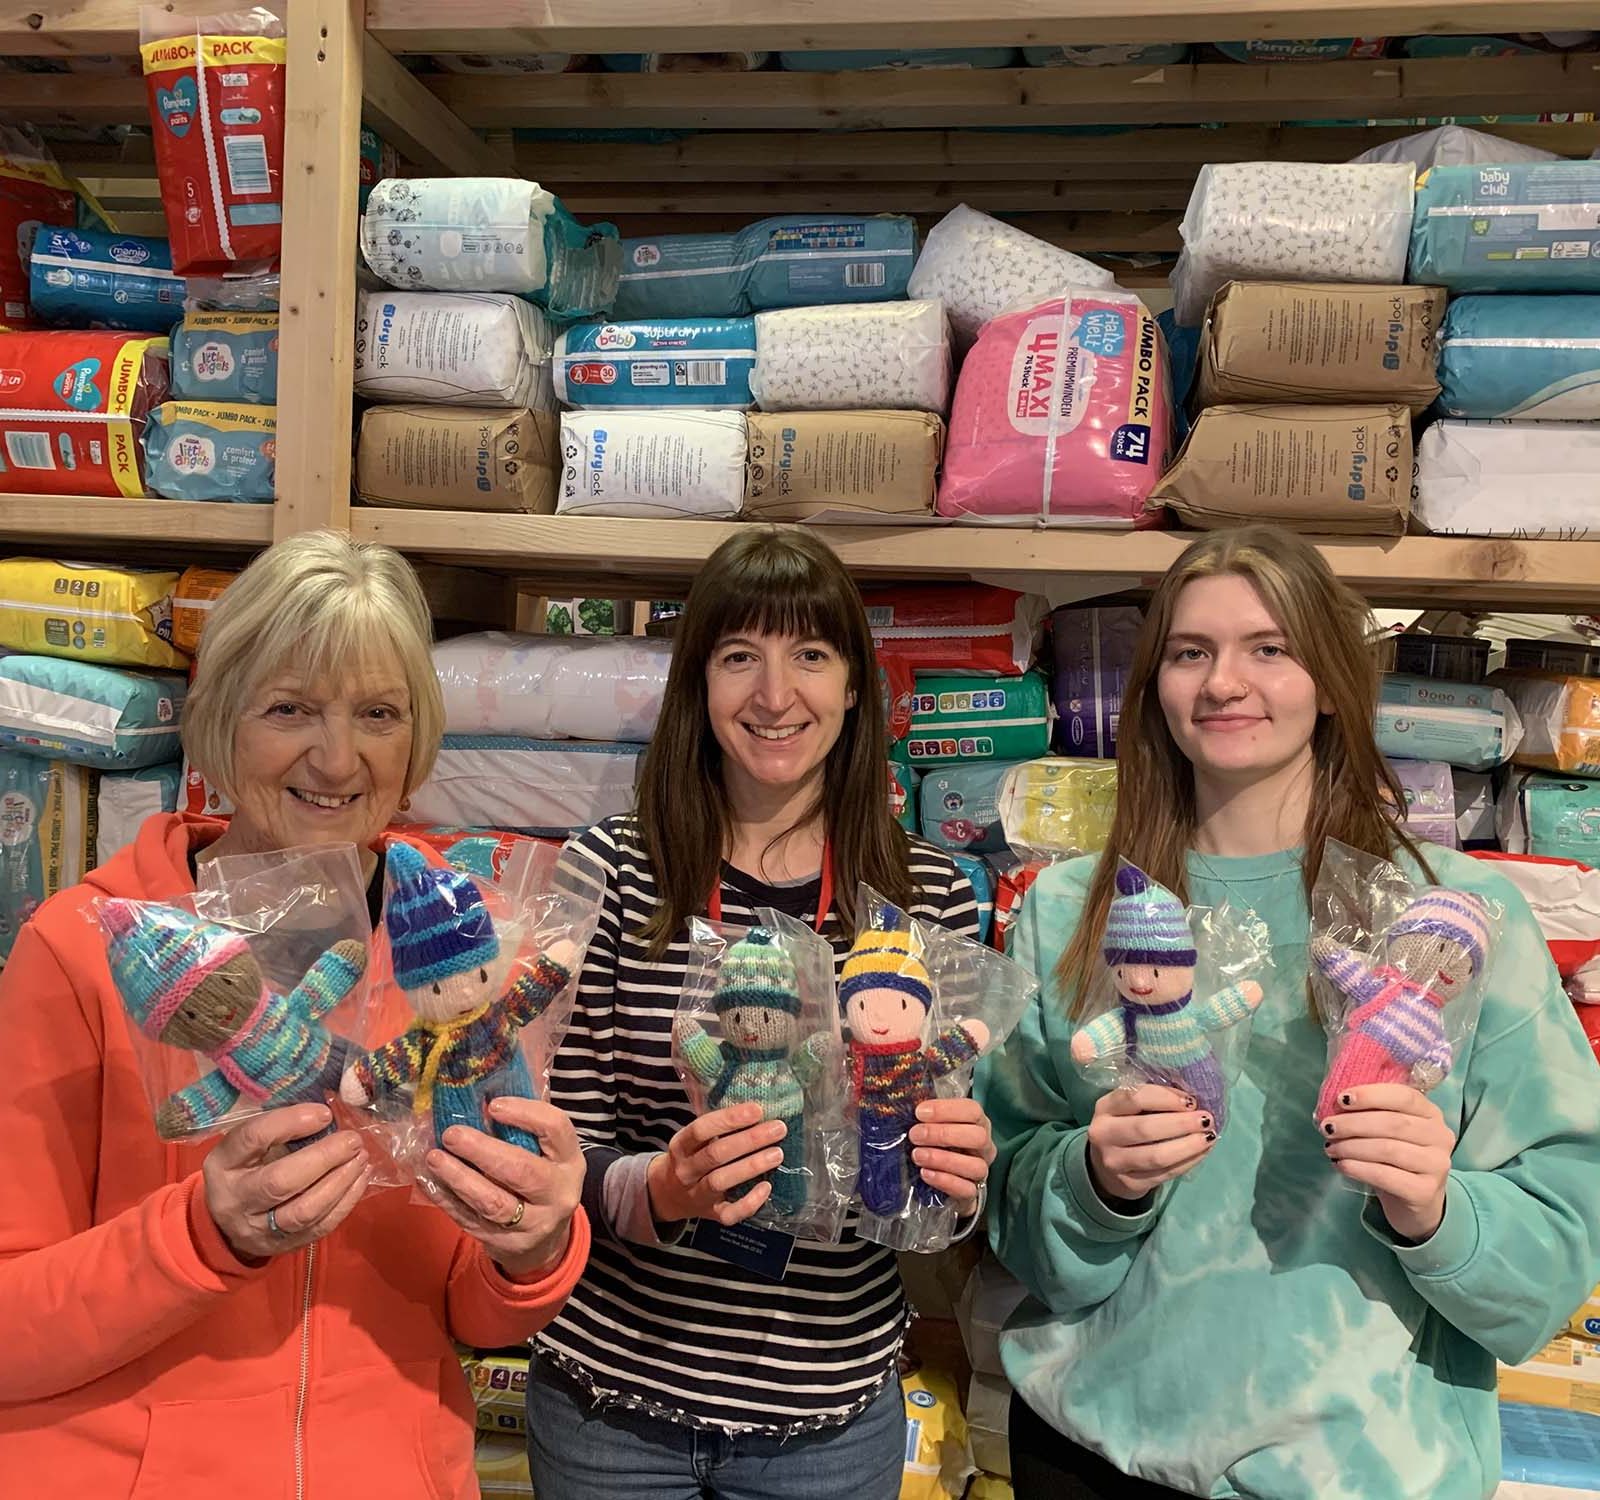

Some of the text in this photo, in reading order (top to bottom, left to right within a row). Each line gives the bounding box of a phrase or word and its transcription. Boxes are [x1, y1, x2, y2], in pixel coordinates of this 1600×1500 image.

[150, 41, 253, 63] JUMBO+ PACK
[163, 96, 191, 111] Pampers
[1479, 170, 1510, 185] baby
[187, 183, 194, 197] 5
[1480, 184, 1508, 195] club
[52, 234, 70, 246] 5+
[112, 246, 147, 258] mamia
[1087, 313, 1103, 347] Welt
[1384, 296, 1404, 352] drylock
[600, 333, 633, 347] baby
[1102, 313, 1120, 353] Hallo
[378, 317, 393, 369] drylock
[202, 351, 225, 363] little
[1024, 354, 1034, 365] 74
[197, 361, 230, 375] angels
[602, 368, 614, 377] 30
[1134, 316, 1154, 418] JUMBO PACK
[9, 376, 21, 385] 5
[62, 372, 72, 395] pants
[74, 367, 92, 402] Pampers
[1028, 354, 1056, 418] MAXI
[1060, 346, 1079, 417] PREMIUMWINDELN
[114, 358, 133, 473] JUMBO+ PACK
[175, 405, 192, 414] UMBO
[192, 407, 210, 417] PACK
[216, 411, 239, 422] JUMBO
[239, 414, 257, 425] PACK
[179, 442, 206, 457] little
[476, 425, 490, 476] drylock
[1125, 431, 1146, 458] 74
[174, 455, 210, 469] angels
[1348, 425, 1368, 483] drylock
[590, 444, 606, 496] drylock
[779, 443, 795, 496] drylock
[74, 581, 81, 590] 2
[90, 583, 97, 592] 3
[993, 697, 1000, 706] 5
[956, 822, 966, 838] 3
[496, 1371, 505, 1382] 4
